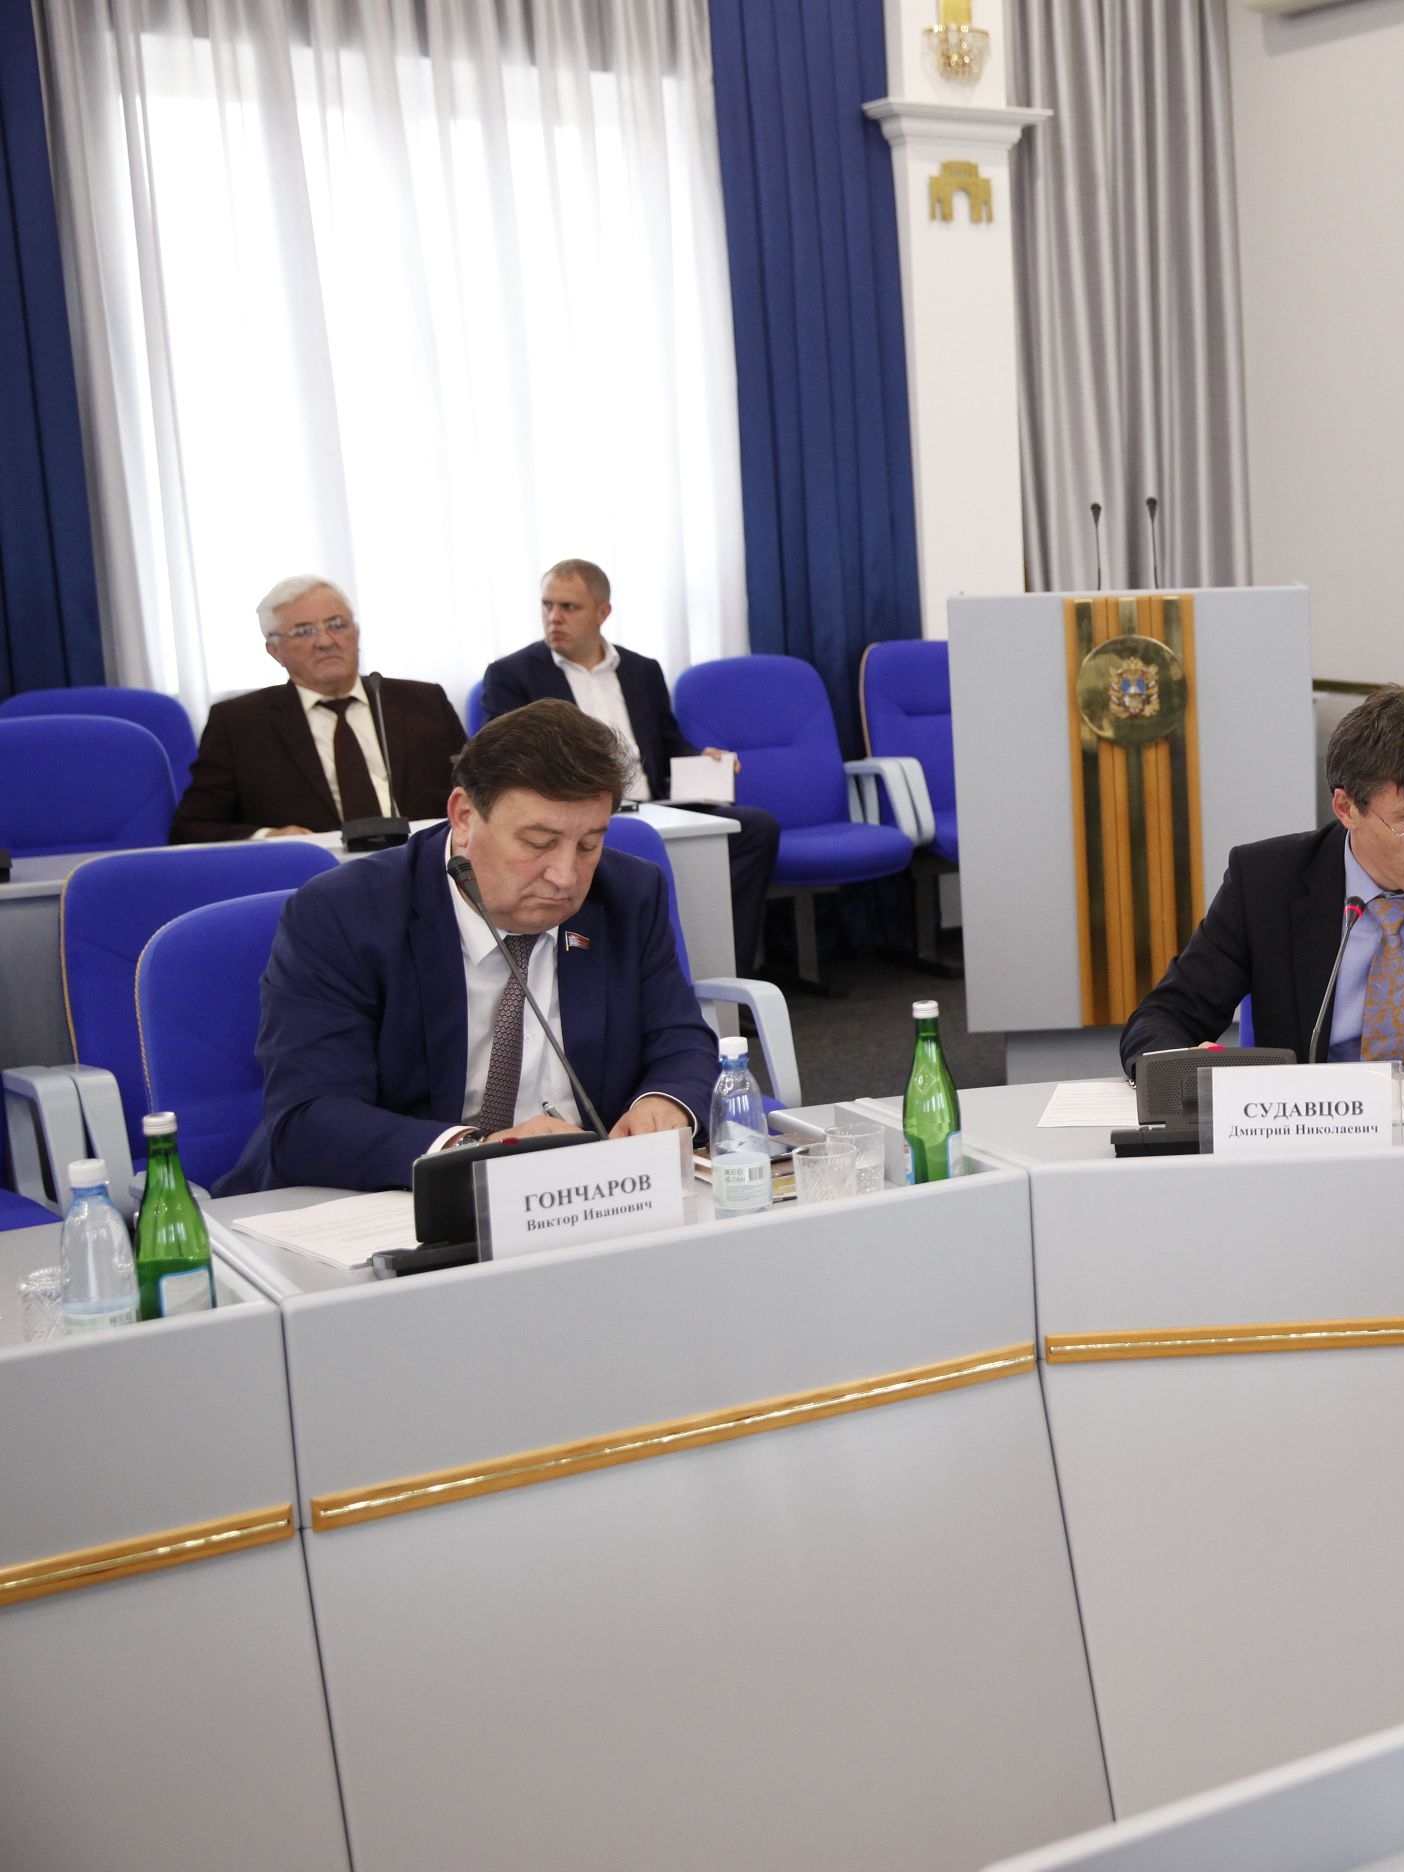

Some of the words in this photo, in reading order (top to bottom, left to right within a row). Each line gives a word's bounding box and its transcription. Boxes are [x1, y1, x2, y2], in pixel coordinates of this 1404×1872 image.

[1243, 1100, 1364, 1120] СУДАВЦОВ
[1229, 1124, 1291, 1138] Дмитрий
[1295, 1124, 1379, 1136] Николаевич
[524, 1174, 652, 1212] ГОНЧАРОВ
[527, 1214, 579, 1232] Виктор
[584, 1200, 653, 1222] Иванович
